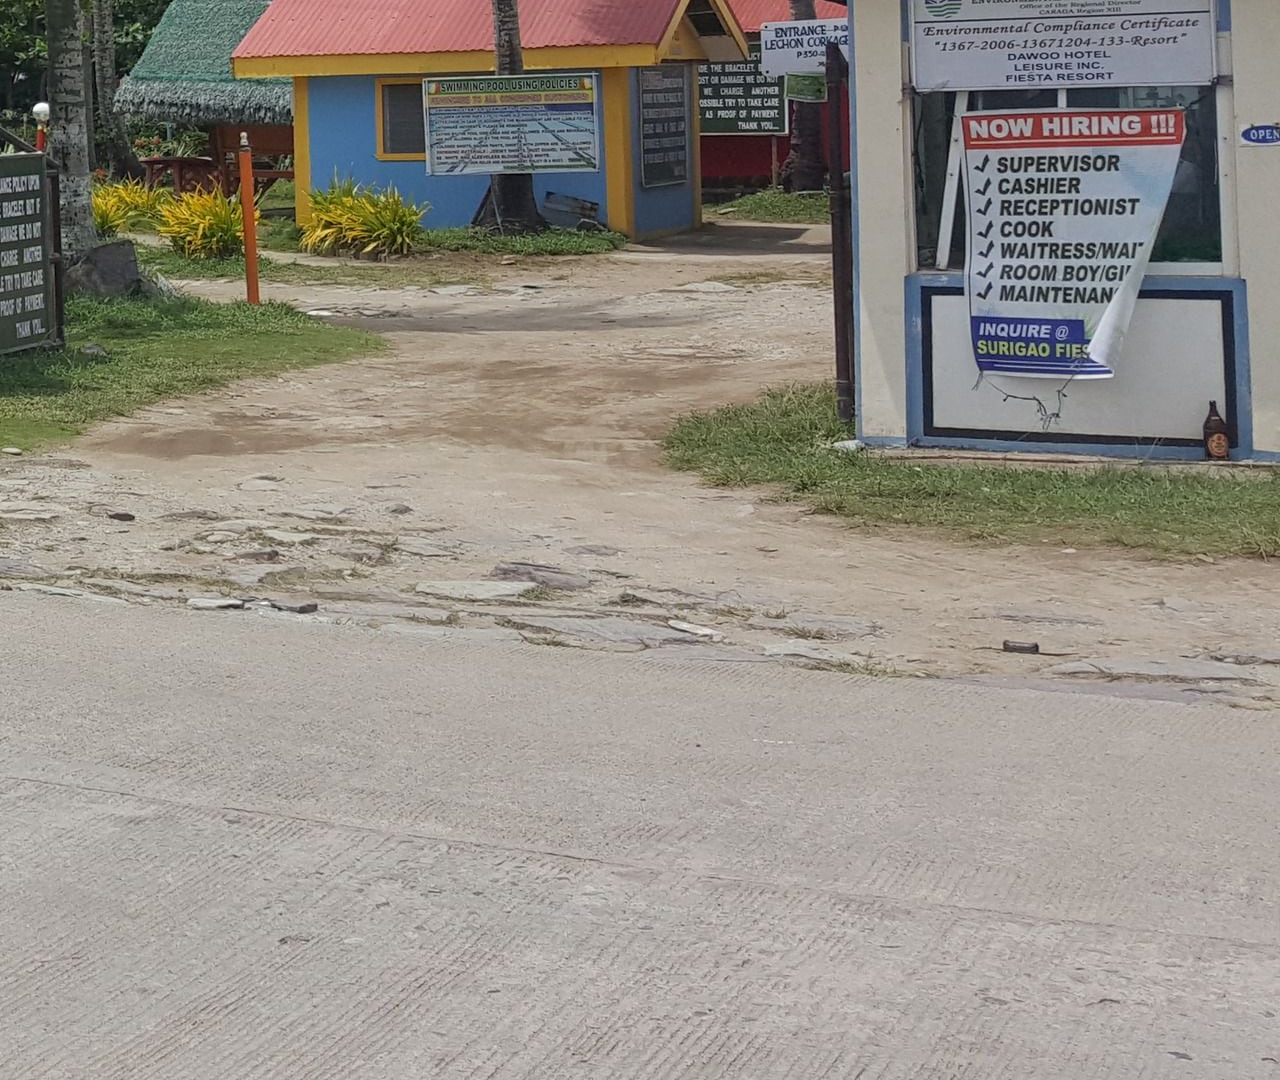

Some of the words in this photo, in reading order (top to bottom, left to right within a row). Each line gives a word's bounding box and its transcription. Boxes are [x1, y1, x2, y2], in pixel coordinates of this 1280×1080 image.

[1071, 1, 1105, 9] Regional
[775, 25, 826, 38] ENTRANCE
[923, 22, 1032, 37] Environmental
[1034, 21, 1115, 35] Compliance
[1120, 17, 1199, 32] Certificate
[765, 38, 804, 50] LECHON
[1008, 52, 1059, 61] DAWOO
[1065, 50, 1111, 59] HOTEL
[1014, 62, 1072, 71] LEISURE
[720, 76, 744, 84] DAMAGE
[1006, 74, 1053, 82] FIESTA
[1057, 72, 1114, 81] RESORT
[441, 81, 484, 92] SWIMMING
[487, 80, 509, 91] POOL
[512, 79, 538, 90] USING
[540, 78, 578, 89] POLICIES
[720, 87, 744, 95] CHARGE
[748, 98, 762, 106] TAKE
[763, 98, 779, 106] CARE
[739, 110, 747, 118] OF
[969, 118, 1034, 139] NOW
[1042, 115, 1141, 137] HIRING
[1151, 114, 1175, 134] !!!
[1250, 130, 1280, 140] OPEN
[997, 155, 1120, 173] SUPERVISOR
[998, 177, 1081, 195] CASHIER
[999, 198, 1140, 216] RECEPTIONIST
[1000, 221, 1054, 237] COOK
[1001, 242, 1144, 259] WAITRESS/WAI
[1000, 264, 1057, 281] ROOM
[1062, 265, 1131, 282] BOY/GI
[979, 322, 1051, 338] INQUIRE
[1055, 326, 1069, 340] @
[977, 341, 1050, 357] SURIGAO
